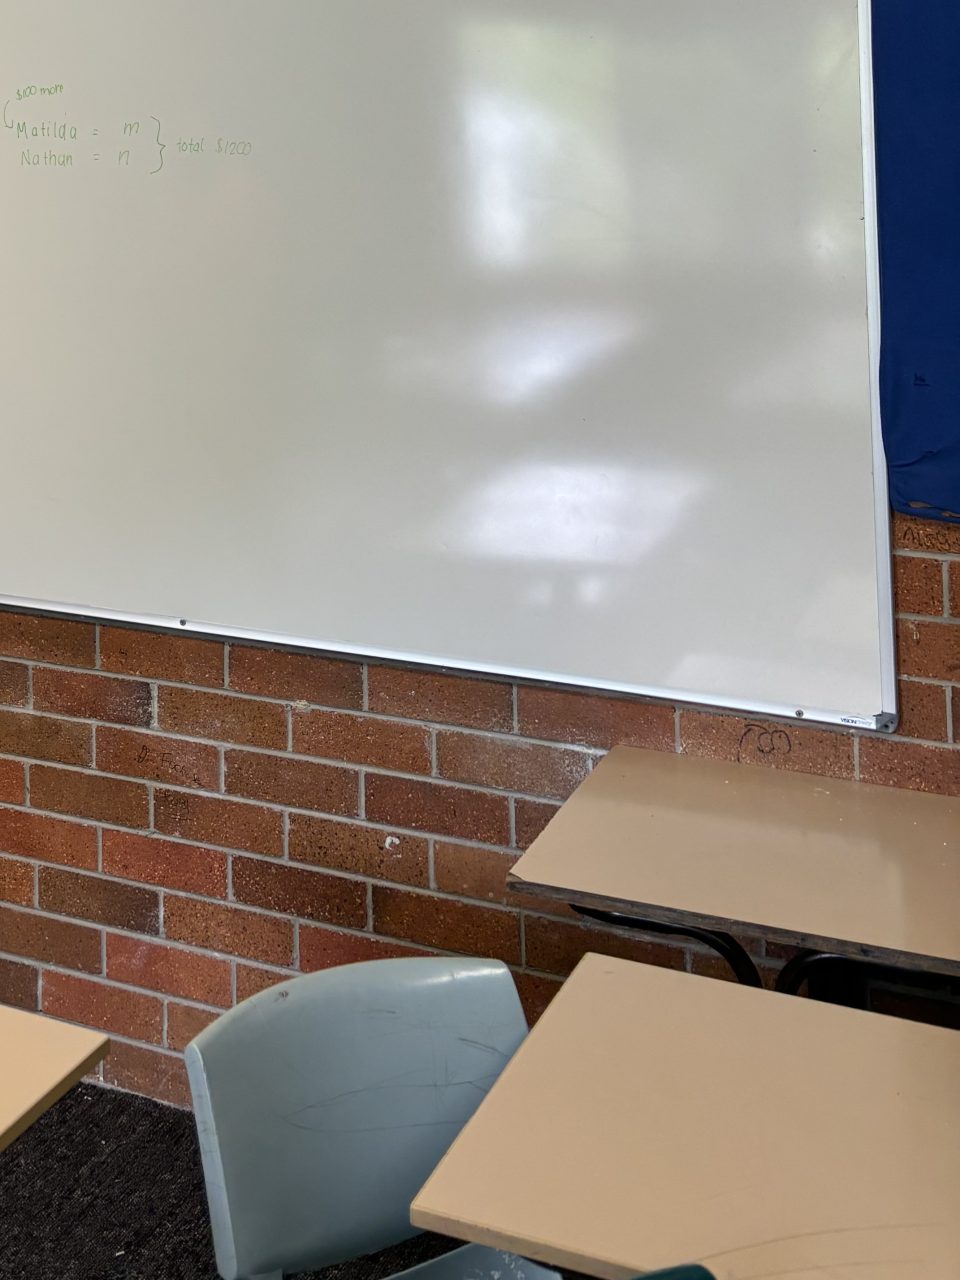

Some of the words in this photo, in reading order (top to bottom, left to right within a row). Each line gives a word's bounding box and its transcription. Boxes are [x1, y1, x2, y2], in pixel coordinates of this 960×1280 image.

[15, 84, 38, 101] $100
[40, 83, 64, 96] more
[16, 120, 77, 140] Matilda
[176, 137, 204, 153] total
[215, 137, 252, 156] $1200
[21, 150, 73, 166] Nathan
